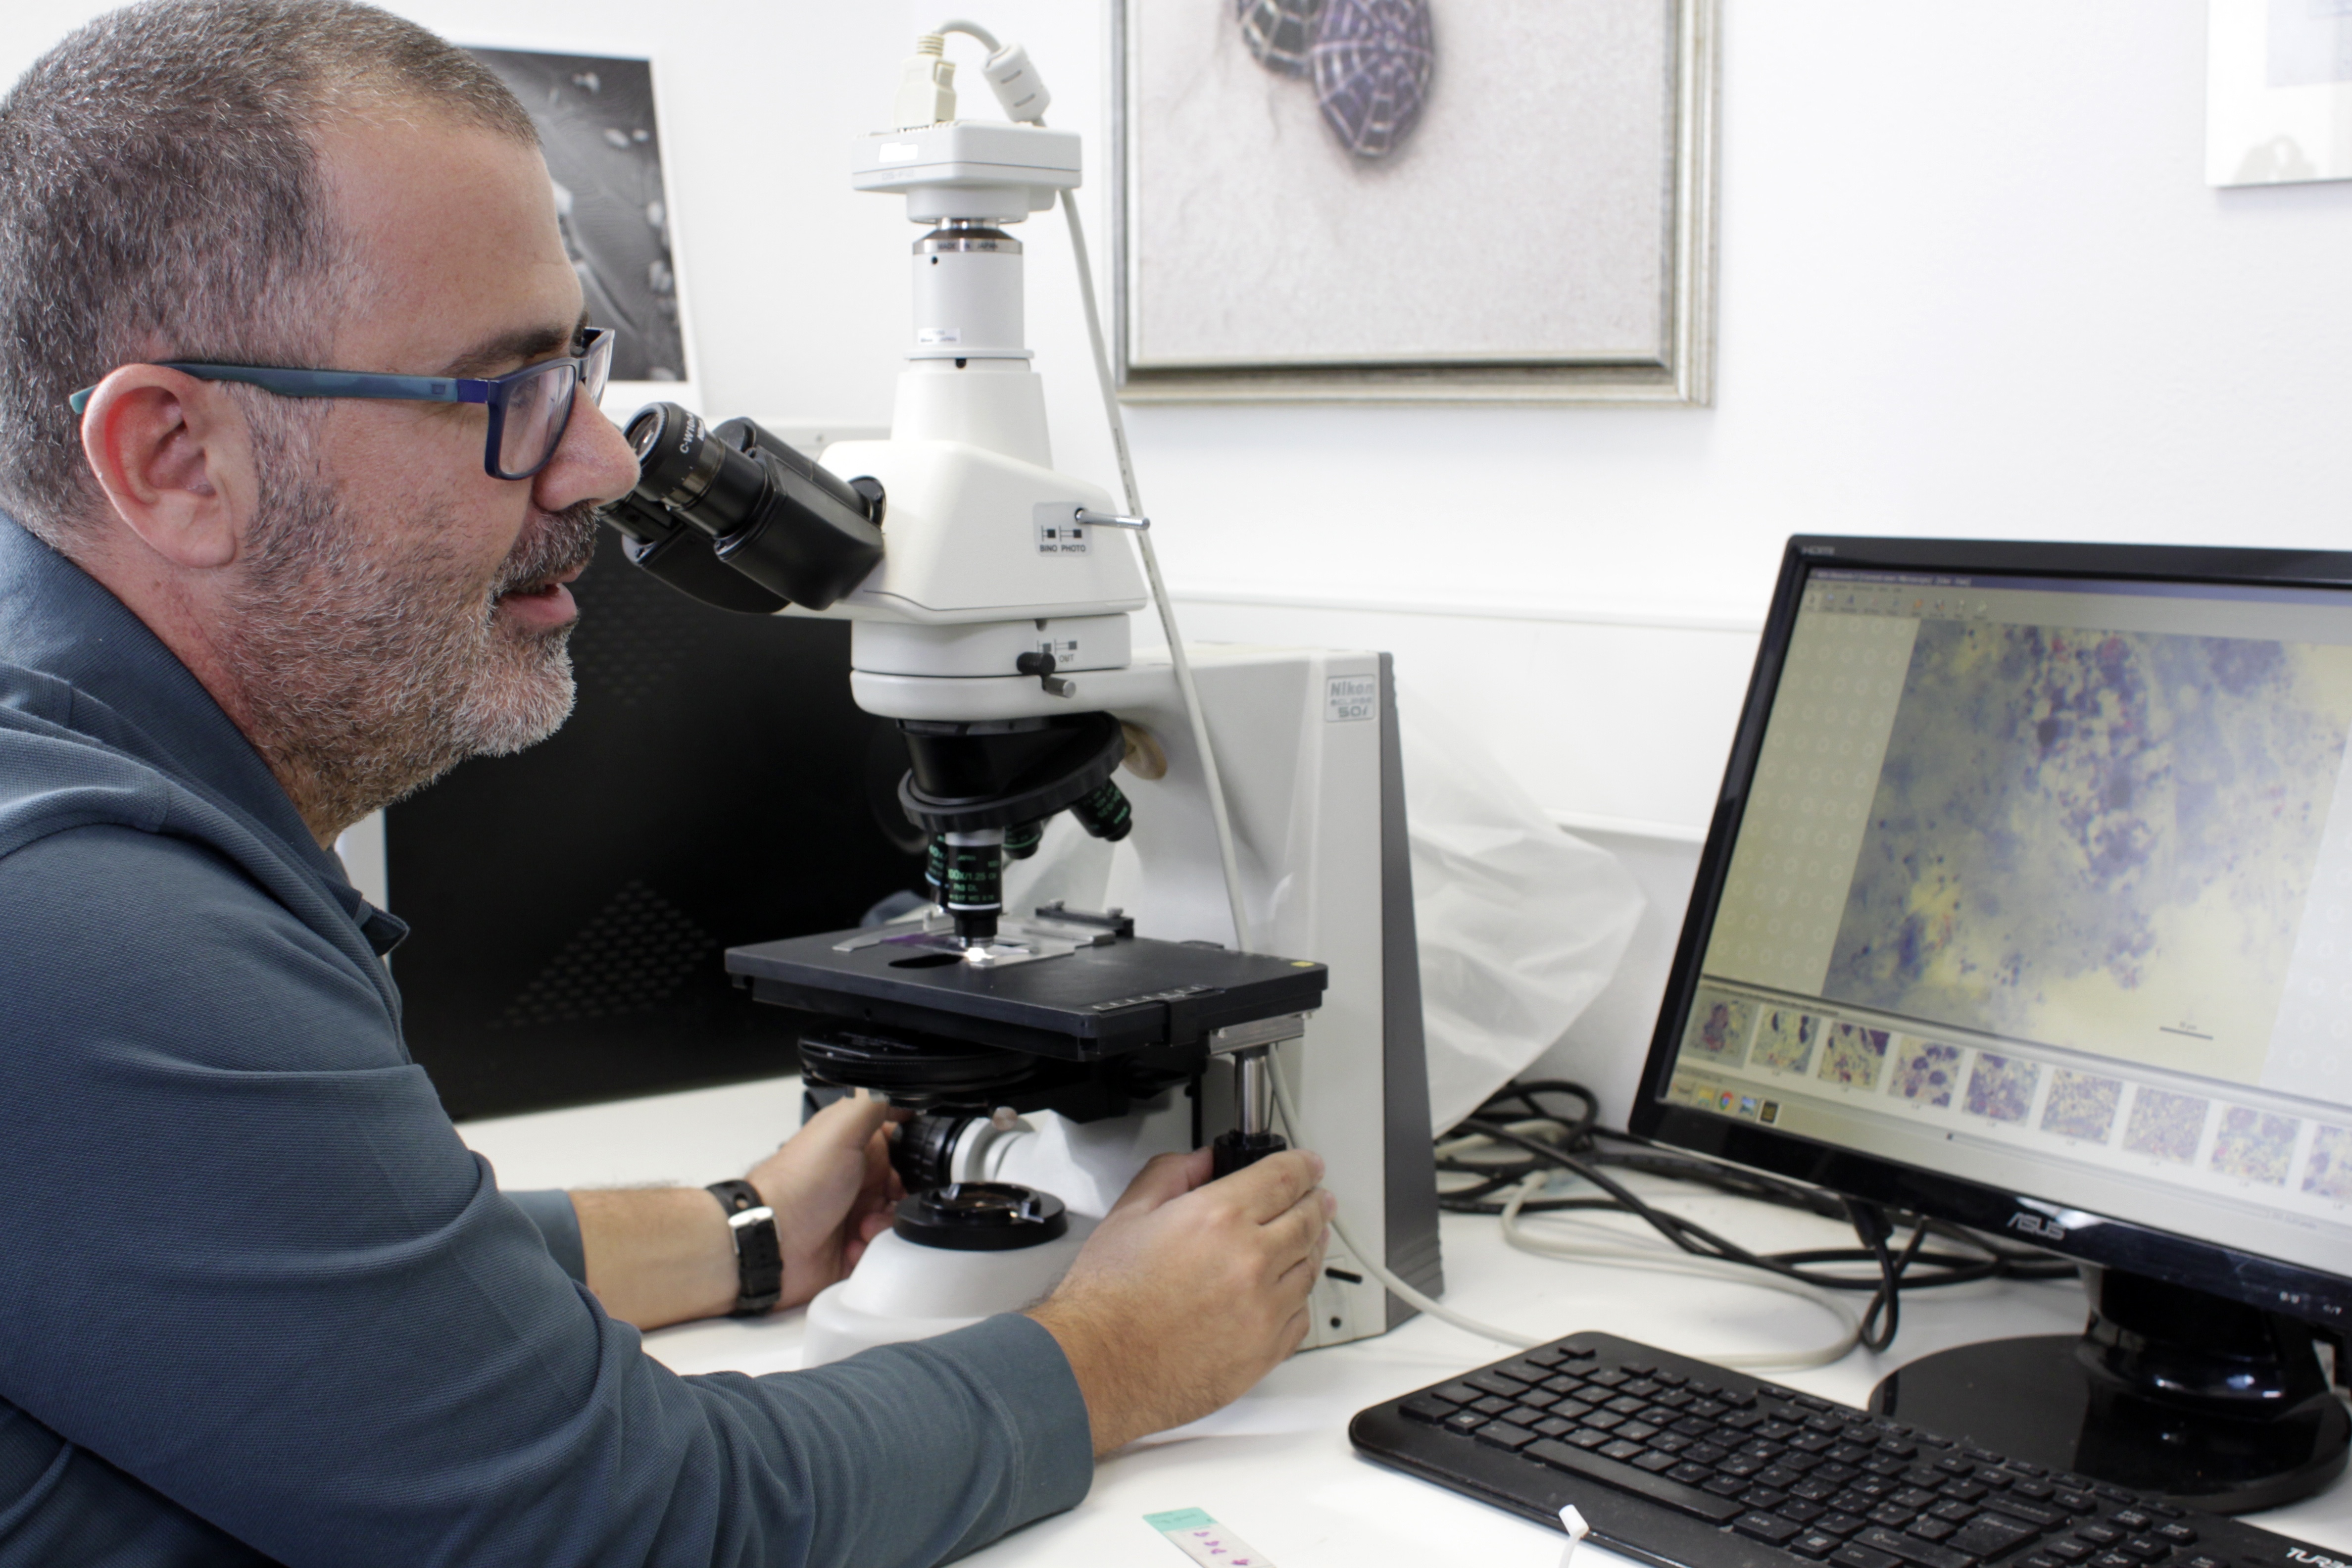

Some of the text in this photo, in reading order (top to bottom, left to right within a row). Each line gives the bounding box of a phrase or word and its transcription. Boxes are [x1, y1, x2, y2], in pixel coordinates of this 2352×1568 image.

[1040, 544, 1086, 552] BINO PHOTO
[1059, 654, 1075, 662] OUT
[1330, 681, 1374, 696] Nikon
[2007, 1213, 2066, 1240] ASUS
